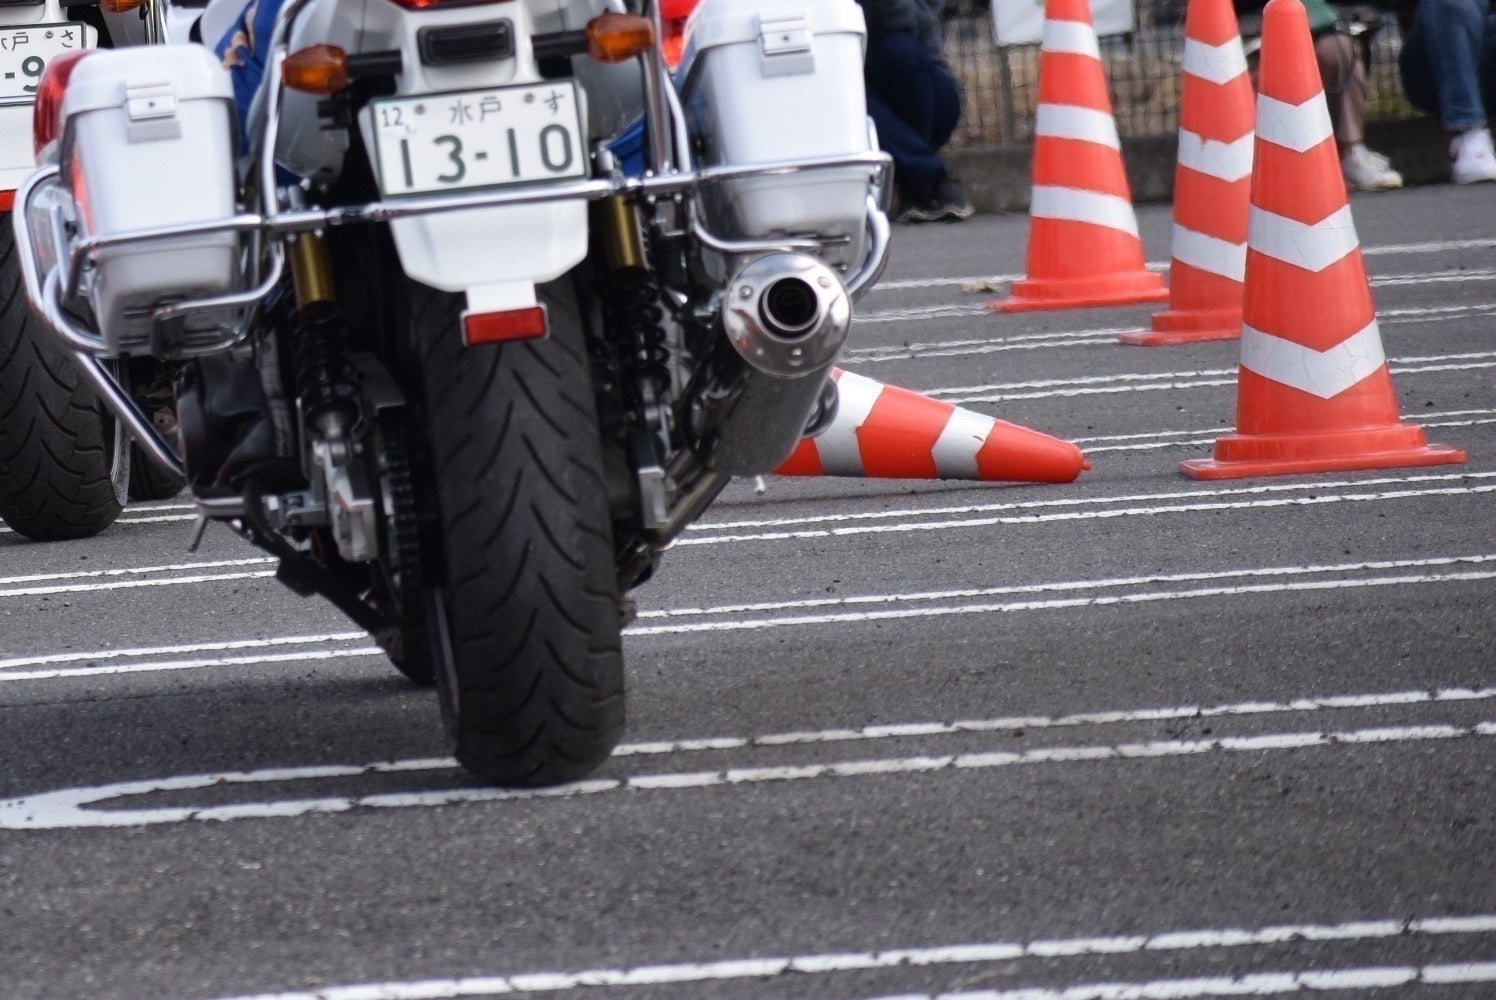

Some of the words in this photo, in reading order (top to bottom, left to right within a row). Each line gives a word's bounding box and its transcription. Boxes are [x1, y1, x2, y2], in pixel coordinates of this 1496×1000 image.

[60, 29, 74, 48] さ
[380, 106, 403, 128] 12
[449, 95, 502, 125] 水戸
[543, 90, 565, 115] す
[401, 124, 573, 188] 13-10
